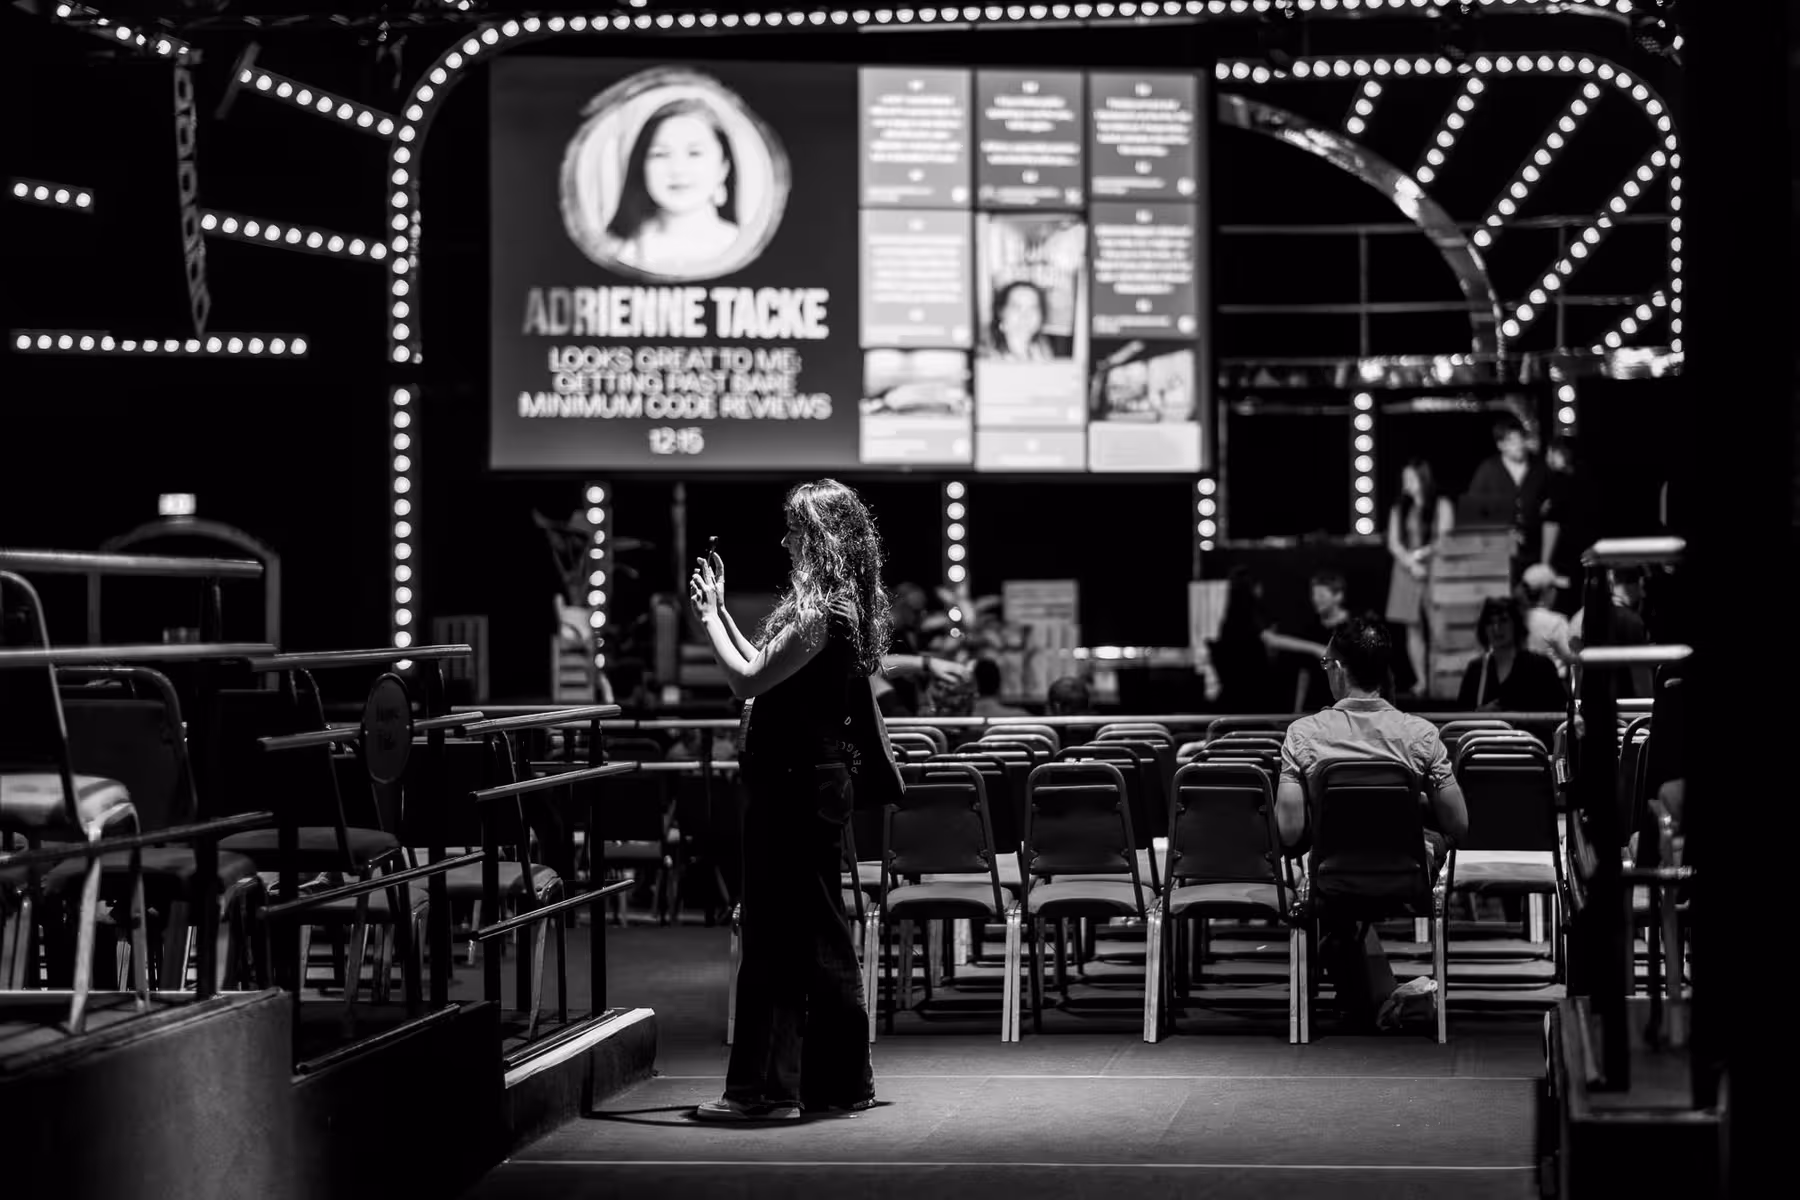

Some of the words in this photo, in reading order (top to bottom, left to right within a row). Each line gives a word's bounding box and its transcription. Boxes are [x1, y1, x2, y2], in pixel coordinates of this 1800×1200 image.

[522, 287, 707, 337] ADRIENNE
[709, 287, 829, 339] TACKE
[548, 347, 633, 373] LOOKS
[634, 347, 717, 371] GREAT
[718, 347, 753, 372] TO
[553, 370, 663, 395] GETTING
[665, 371, 727, 395] PAST
[518, 392, 642, 418] MINIMUM
[644, 393, 718, 419] CODE
[720, 393, 832, 419] REVIEWS
